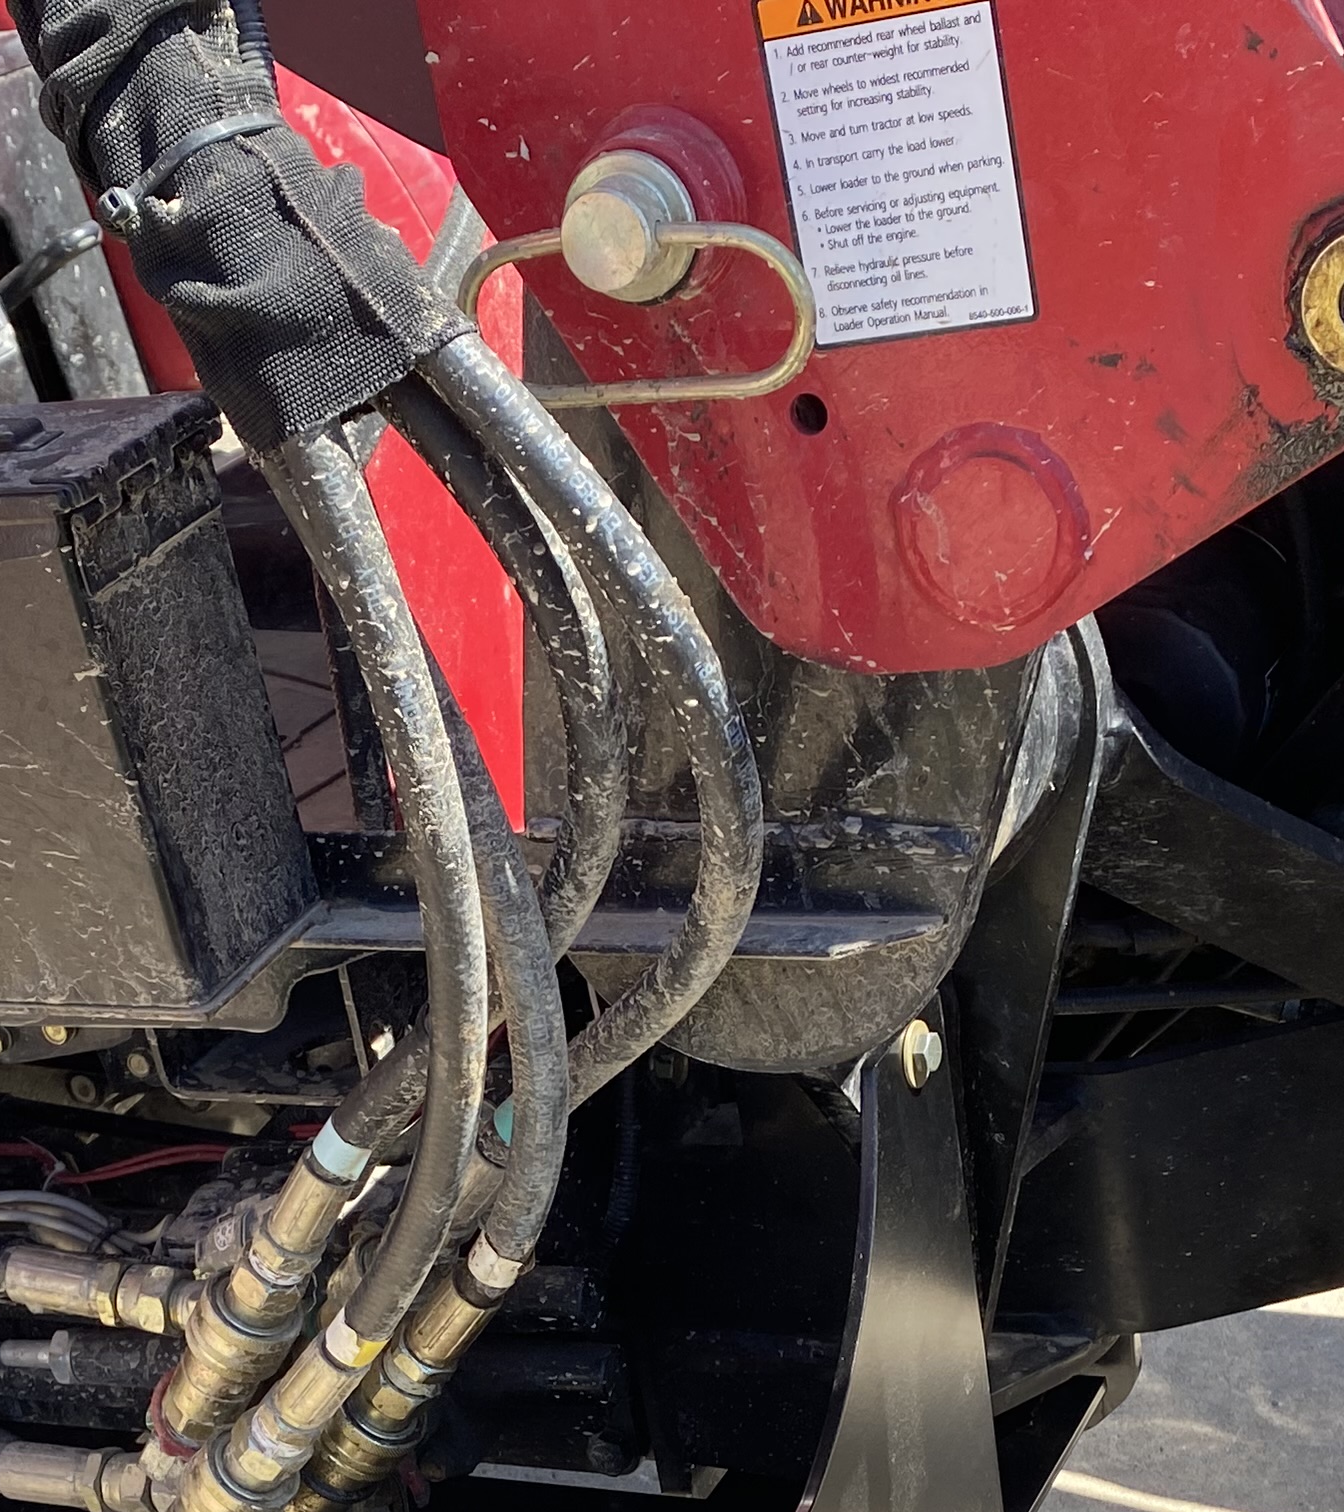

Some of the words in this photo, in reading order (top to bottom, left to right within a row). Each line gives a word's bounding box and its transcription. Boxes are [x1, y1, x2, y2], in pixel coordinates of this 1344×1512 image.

[786, 43, 805, 58] Add
[807, 30, 874, 54] recommended
[875, 29, 895, 42] rear
[897, 20, 927, 38] wheel
[928, 16, 961, 32] ballast
[963, 10, 982, 26] and
[797, 62, 807, 73] or
[810, 58, 829, 71] rear
[831, 44, 905, 67] counter-weight
[906, 41, 920, 54] for
[793, 88, 819, 101] Move
[821, 80, 854, 96] wheels
[856, 79, 867, 90] to
[869, 72, 901, 88] widest
[902, 59, 970, 82] recommended
[796, 103, 829, 118] setting
[830, 99, 843, 111] for
[846, 92, 894, 109] increasing
[800, 131, 826, 143] Move
[829, 125, 847, 139] and
[848, 123, 869, 136] turn
[870, 117, 903, 132] tractor
[905, 114, 916, 126] at
[917, 112, 935, 124] low
[805, 159, 815, 169] In
[817, 151, 860, 167] transport
[861, 148, 885, 161] carry
[887, 143, 904, 156] the
[906, 138, 927, 153] load
[809, 182, 837, 195] Lower
[839, 176, 868, 190] loader
[871, 175, 882, 185] to
[883, 171, 900, 183] the
[902, 163, 936, 183] ground
[938, 161, 964, 175] when
[814, 207, 844, 221] Before
[846, 200, 887, 216] servicing
[889, 198, 900, 209] or
[902, 191, 946, 208] adjusting
[824, 222, 852, 235] Lower
[855, 219, 871, 230] the
[873, 214, 902, 227] loader
[904, 212, 915, 223] to
[917, 209, 934, 221] the
[827, 238, 849, 251] Shut
[851, 234, 864, 247] off
[867, 233, 883, 245] the
[823, 263, 856, 276] Relieve
[858, 255, 900, 274] hydraulic
[902, 251, 941, 268] pressure
[943, 245, 974, 259] before
[827, 275, 888, 292] disconnecting
[890, 270, 902, 283] oil
[831, 303, 868, 317] Observe
[870, 298, 898, 312] safety
[900, 288, 976, 307] recommendation
[979, 287, 988, 296] in
[833, 319, 864, 333] Loader
[866, 313, 912, 329] Operation
